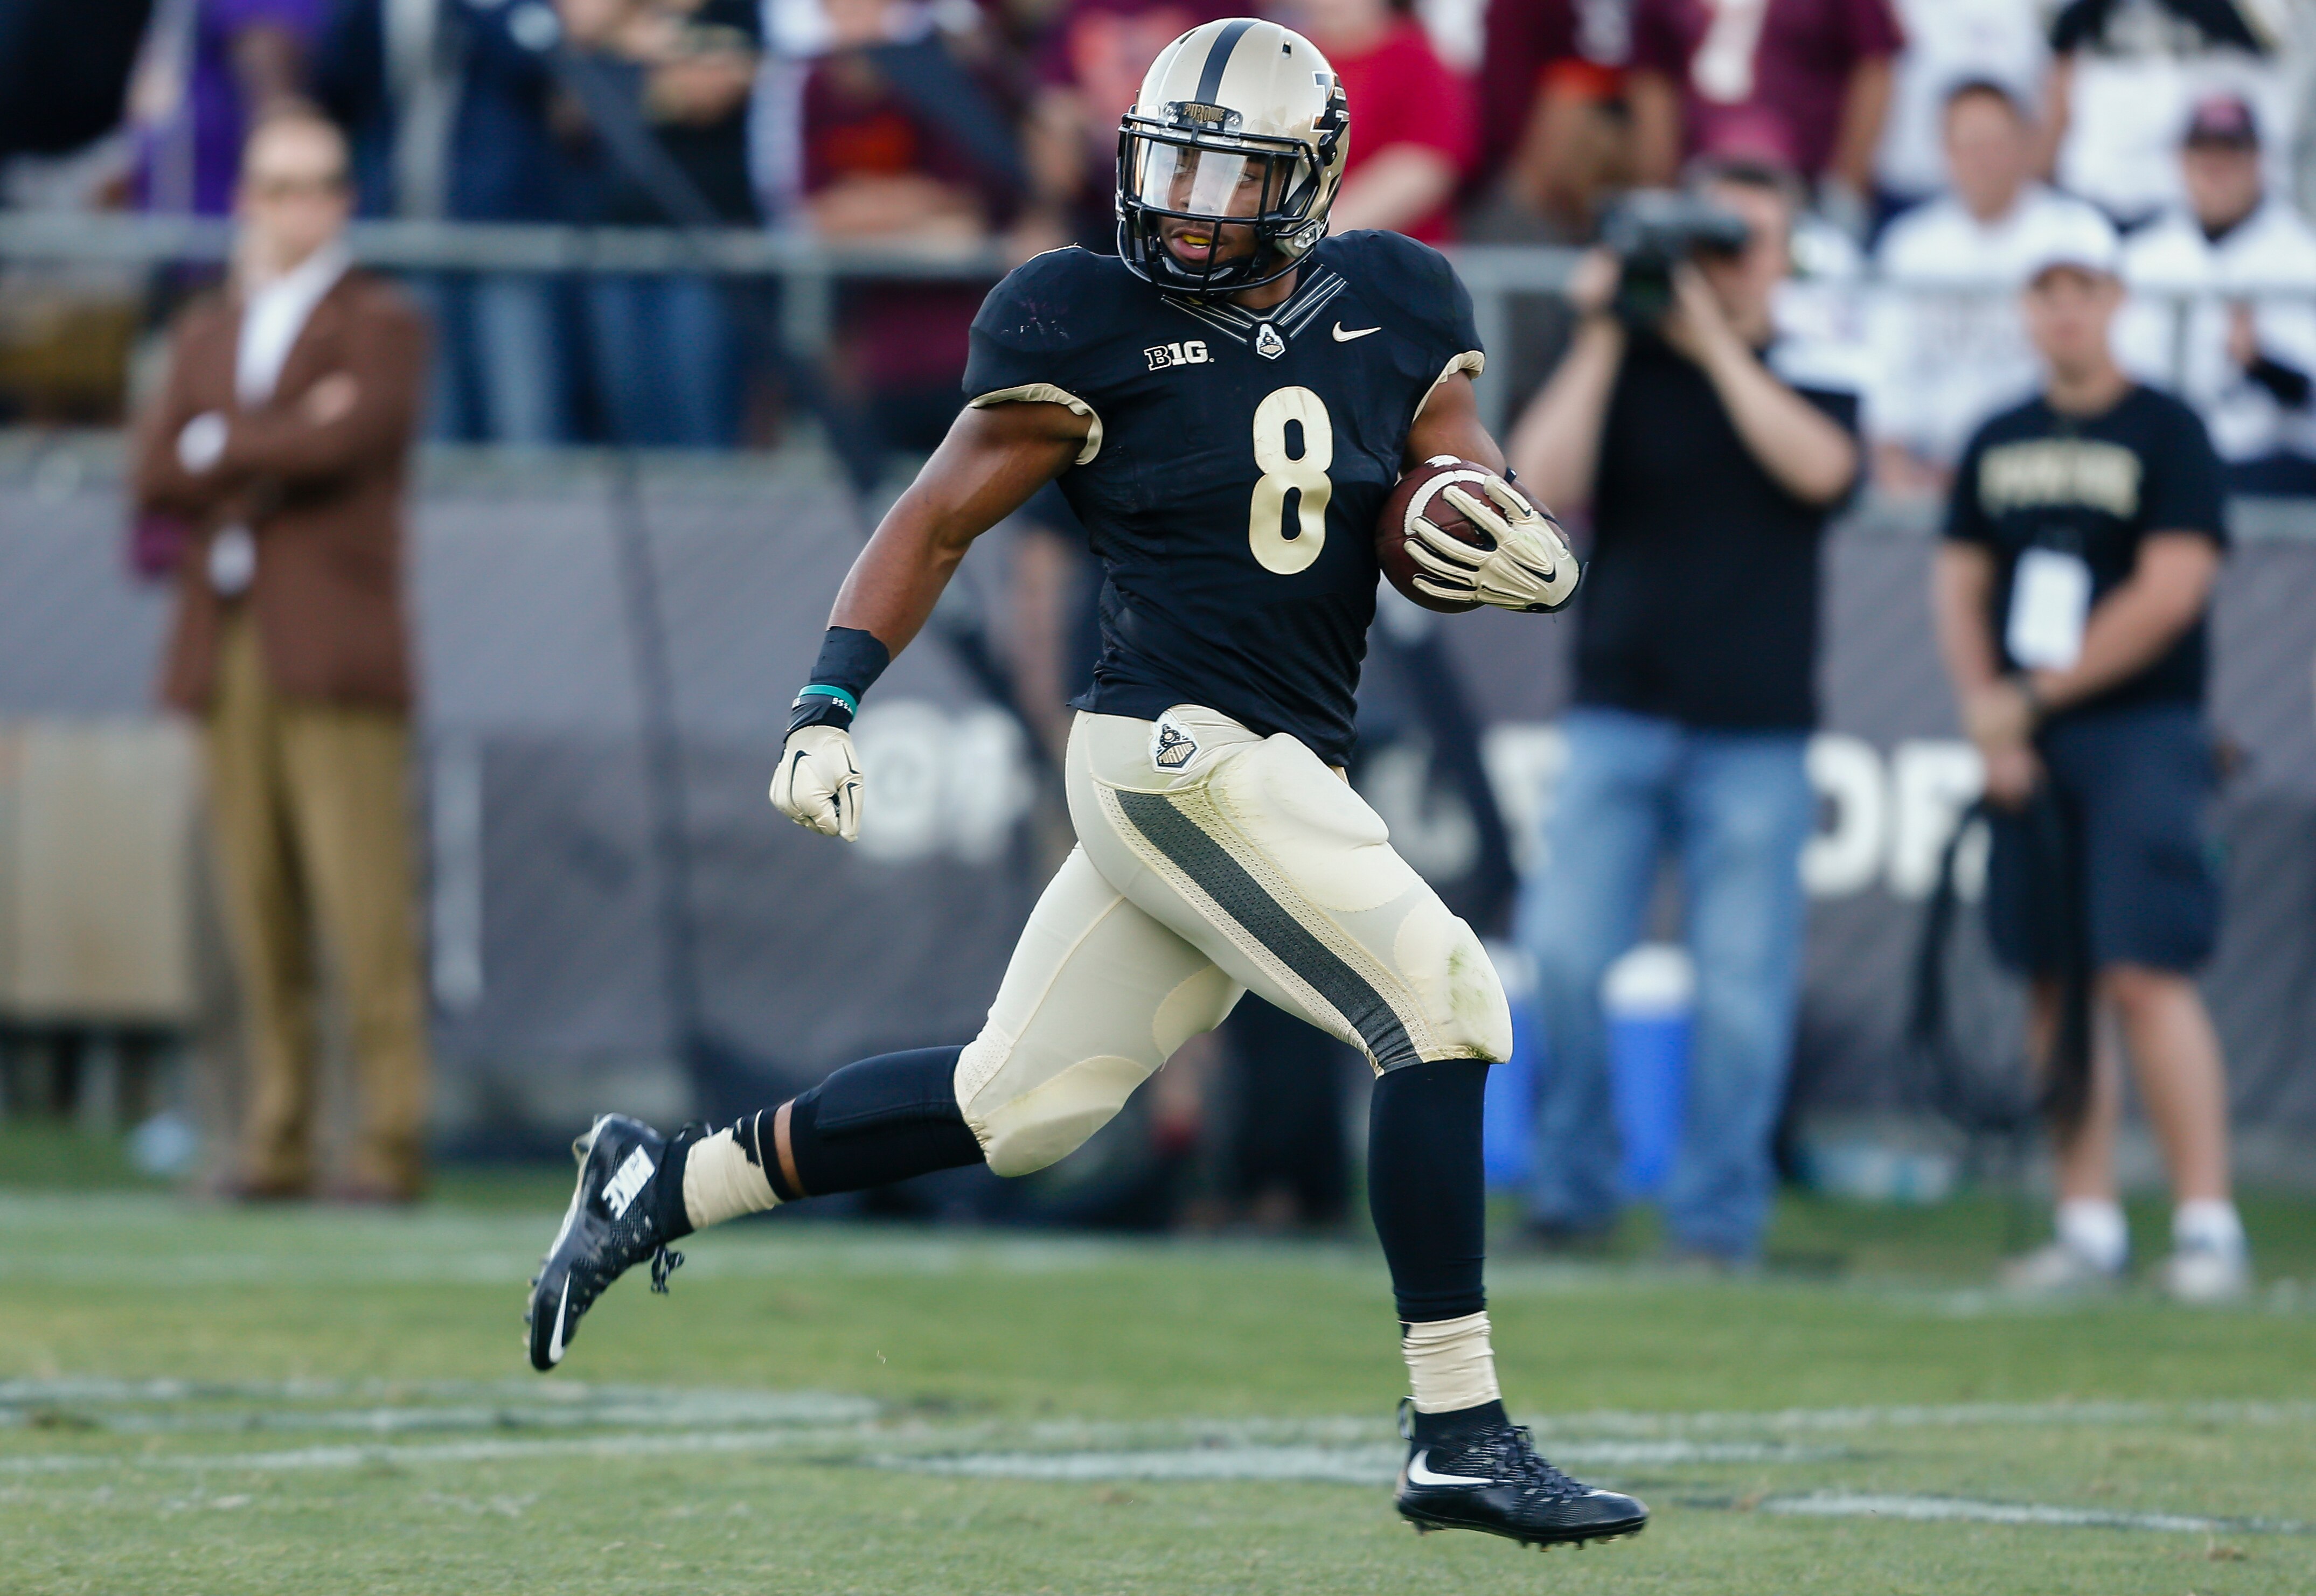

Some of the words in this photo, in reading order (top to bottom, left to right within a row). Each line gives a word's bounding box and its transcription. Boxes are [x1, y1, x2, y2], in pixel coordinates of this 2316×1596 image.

[1183, 103, 1225, 123] PURDUE
[1248, 385, 1333, 575] 8
[1158, 742, 1195, 764] PURDUE
[601, 1143, 656, 1221] NIKE
